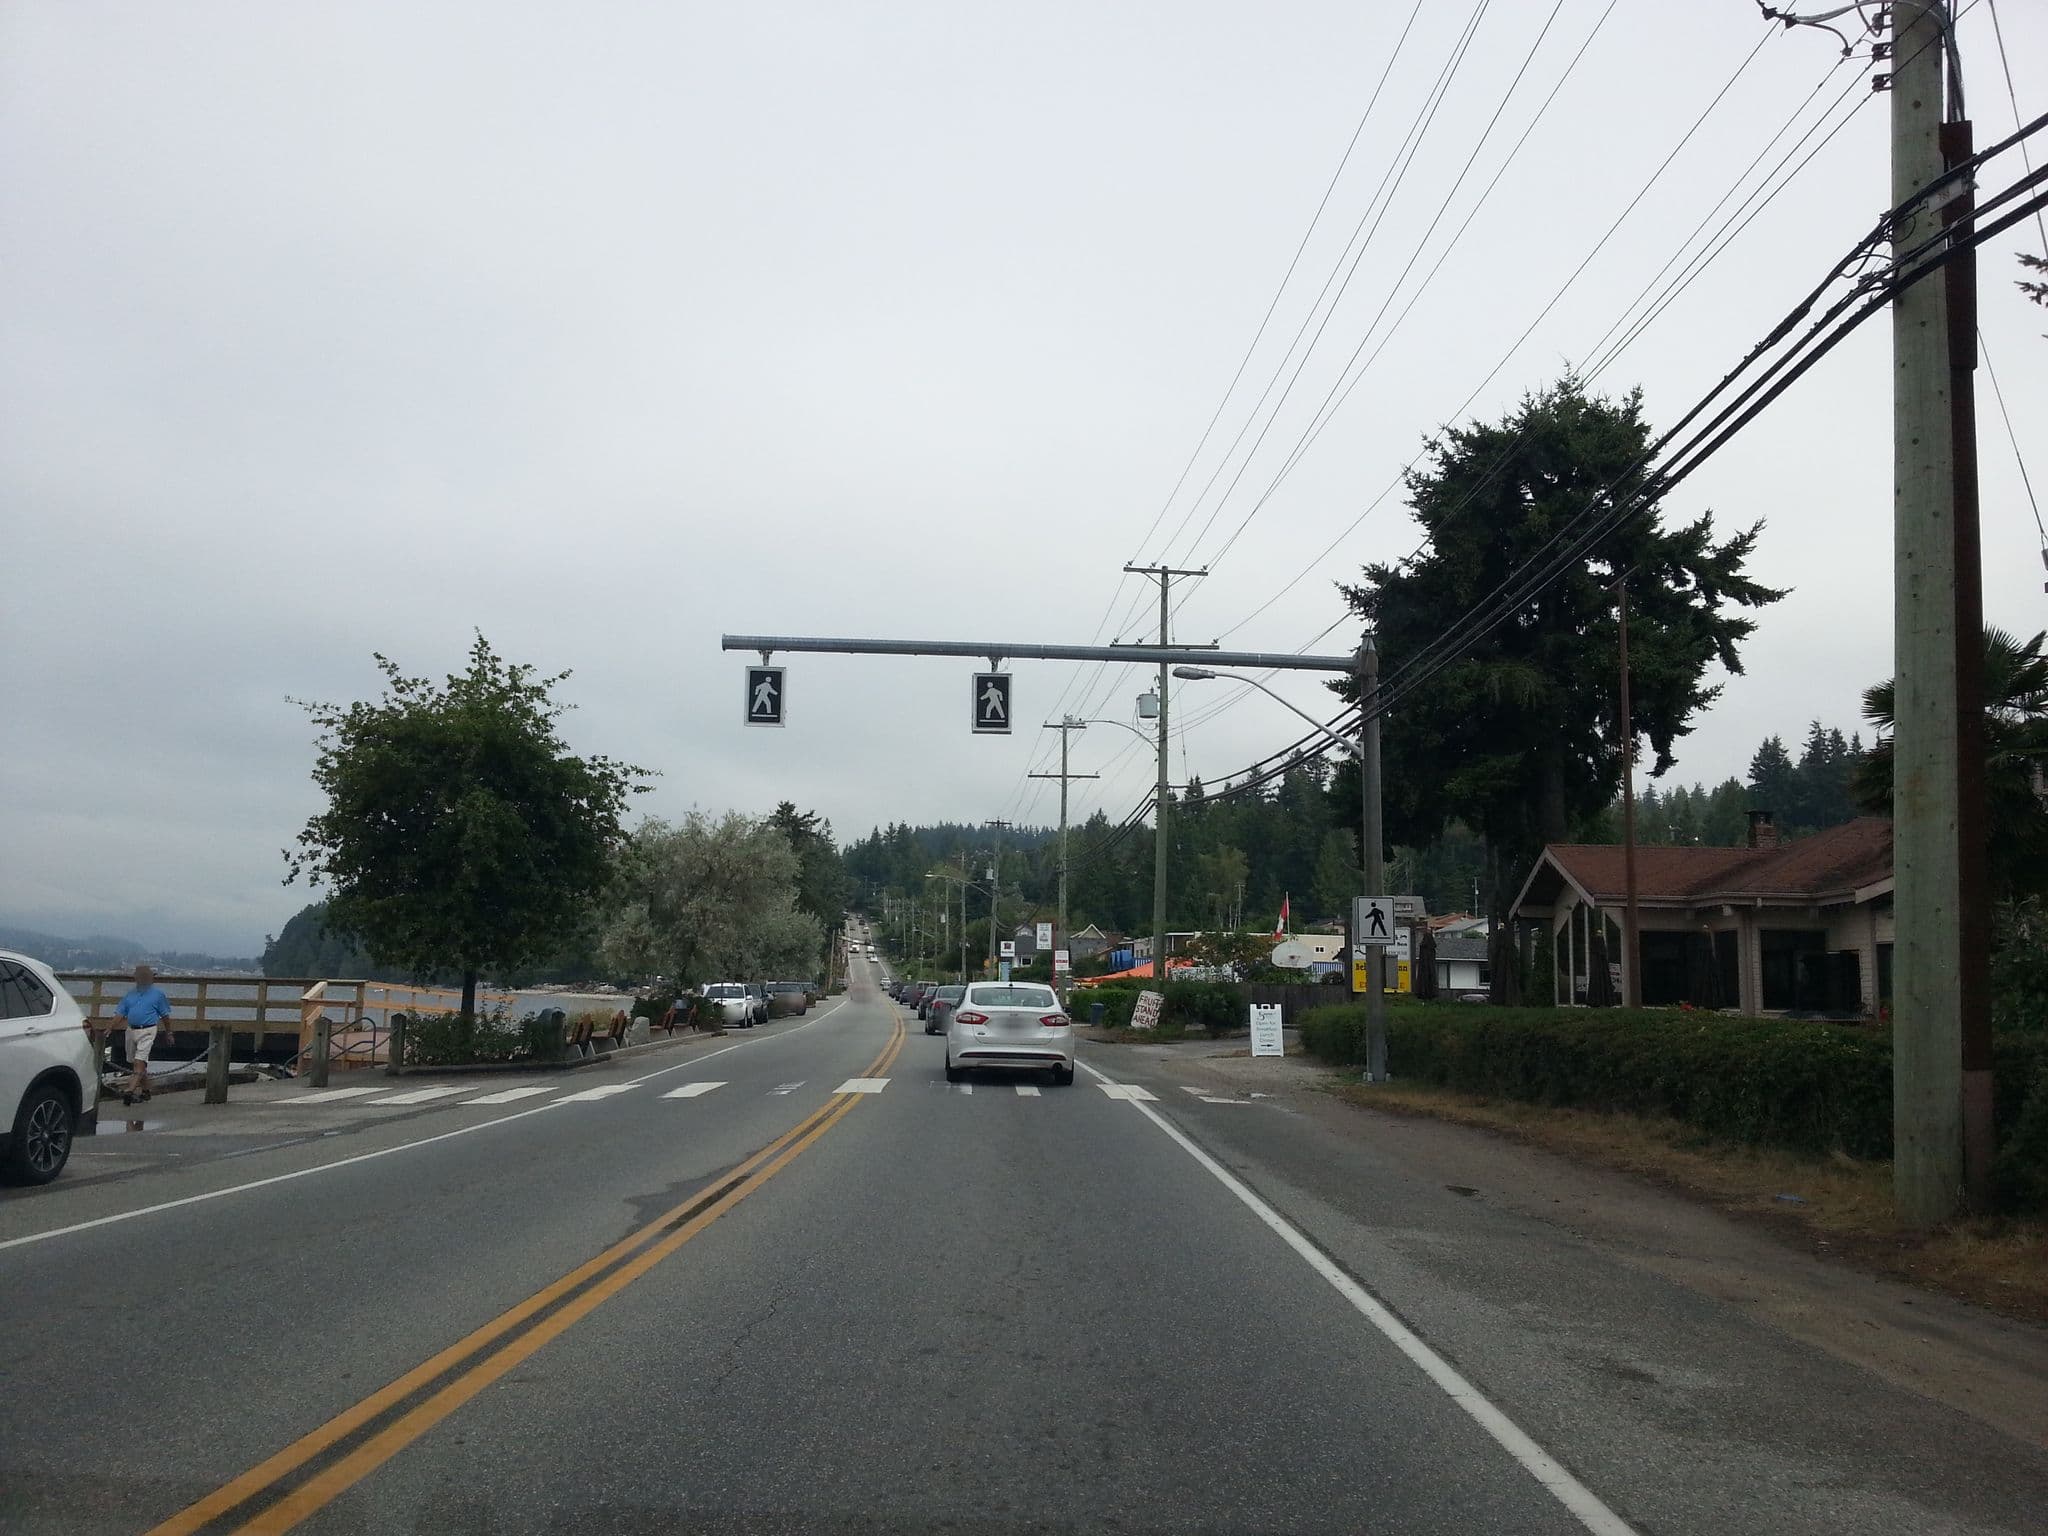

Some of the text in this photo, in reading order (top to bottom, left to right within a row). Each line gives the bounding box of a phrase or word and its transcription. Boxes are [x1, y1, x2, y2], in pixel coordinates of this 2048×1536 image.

[1139, 994, 1160, 1009] FRUIT
[1136, 1004, 1159, 1018] STAND
[1133, 1014, 1157, 1027] AHEAD
